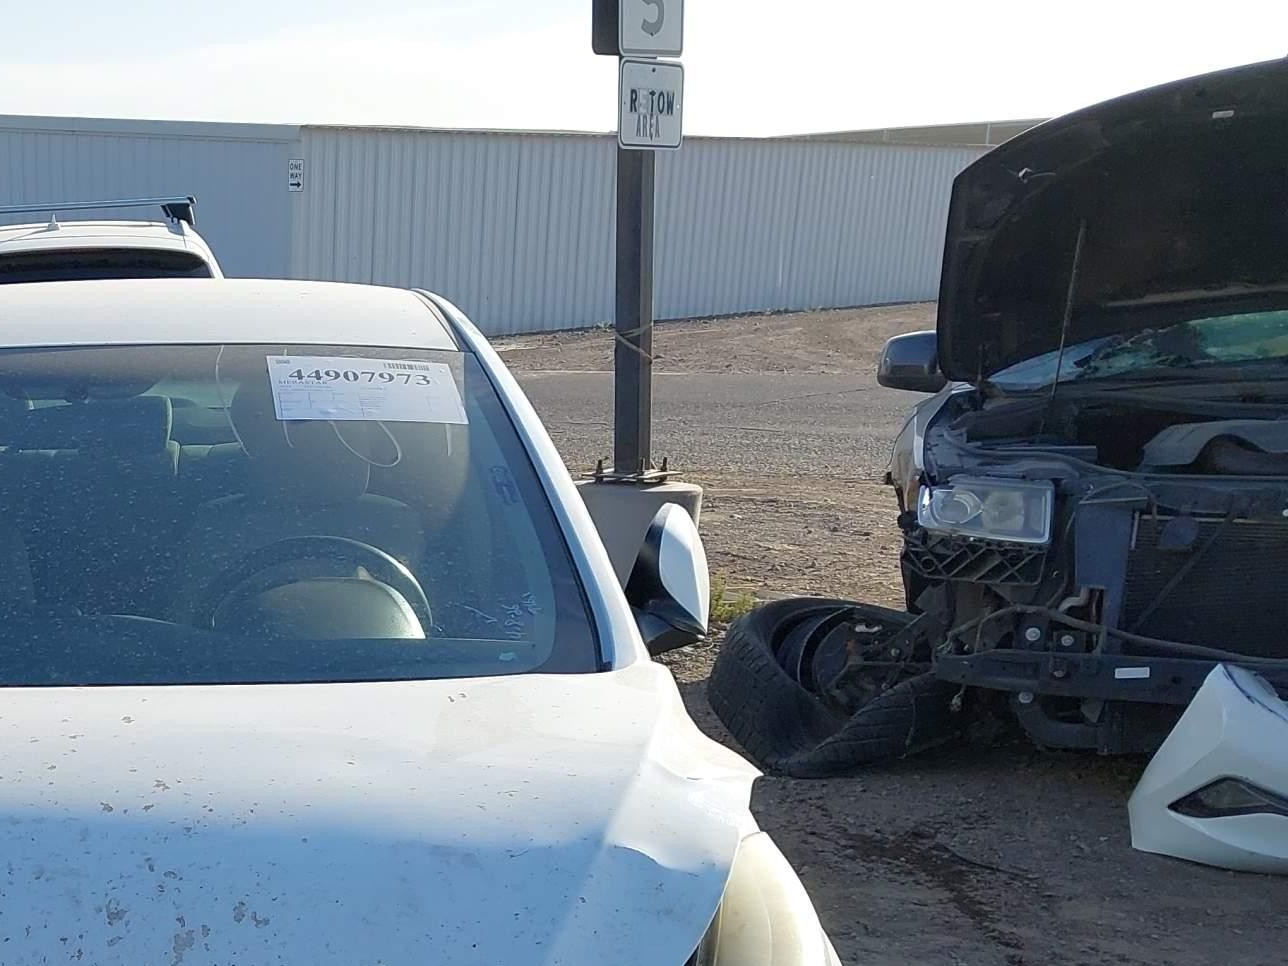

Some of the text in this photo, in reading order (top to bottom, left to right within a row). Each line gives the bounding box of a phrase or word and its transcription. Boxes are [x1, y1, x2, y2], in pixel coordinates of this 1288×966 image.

[630, 88, 675, 116] RTOW
[636, 114, 661, 138] AREA
[289, 162, 302, 171] ONE
[290, 172, 302, 180] WAY
[288, 368, 432, 386] 44907973
